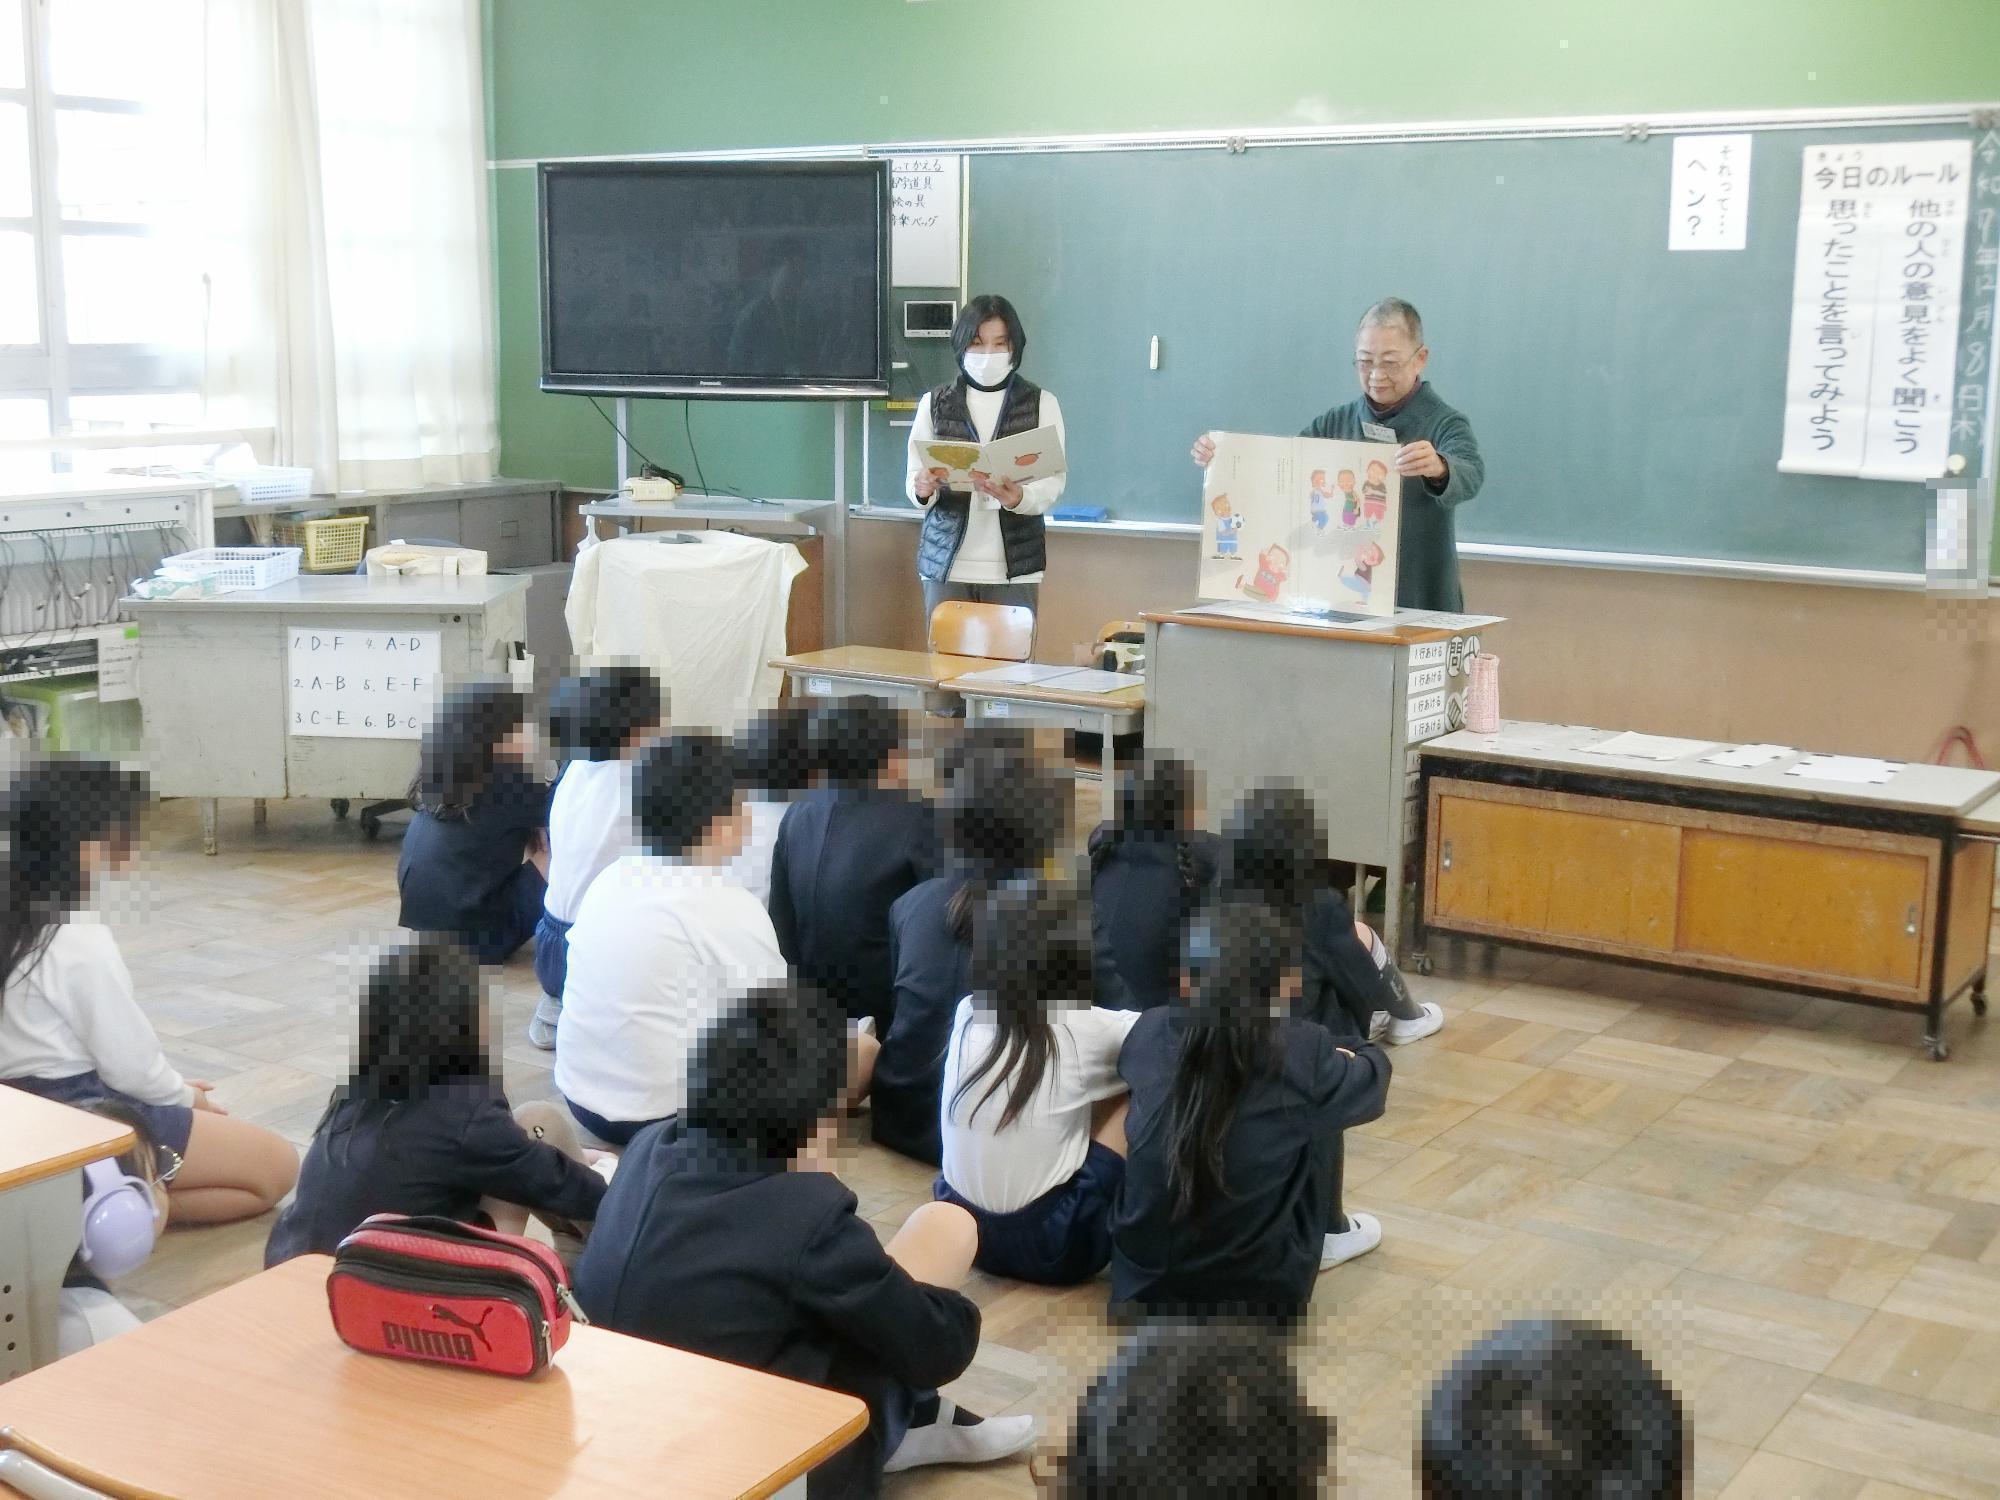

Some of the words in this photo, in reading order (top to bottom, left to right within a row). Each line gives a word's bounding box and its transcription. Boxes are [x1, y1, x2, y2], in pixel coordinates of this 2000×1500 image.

[893, 159, 942, 171] ってかえる
[1814, 163, 1960, 190] 今日のルール
[1809, 199, 1857, 451] 思ったことを言ってみよう
[1892, 199, 1941, 455] 他の人の意見をよく聞こう
[382, 1321, 478, 1362] PUMA
